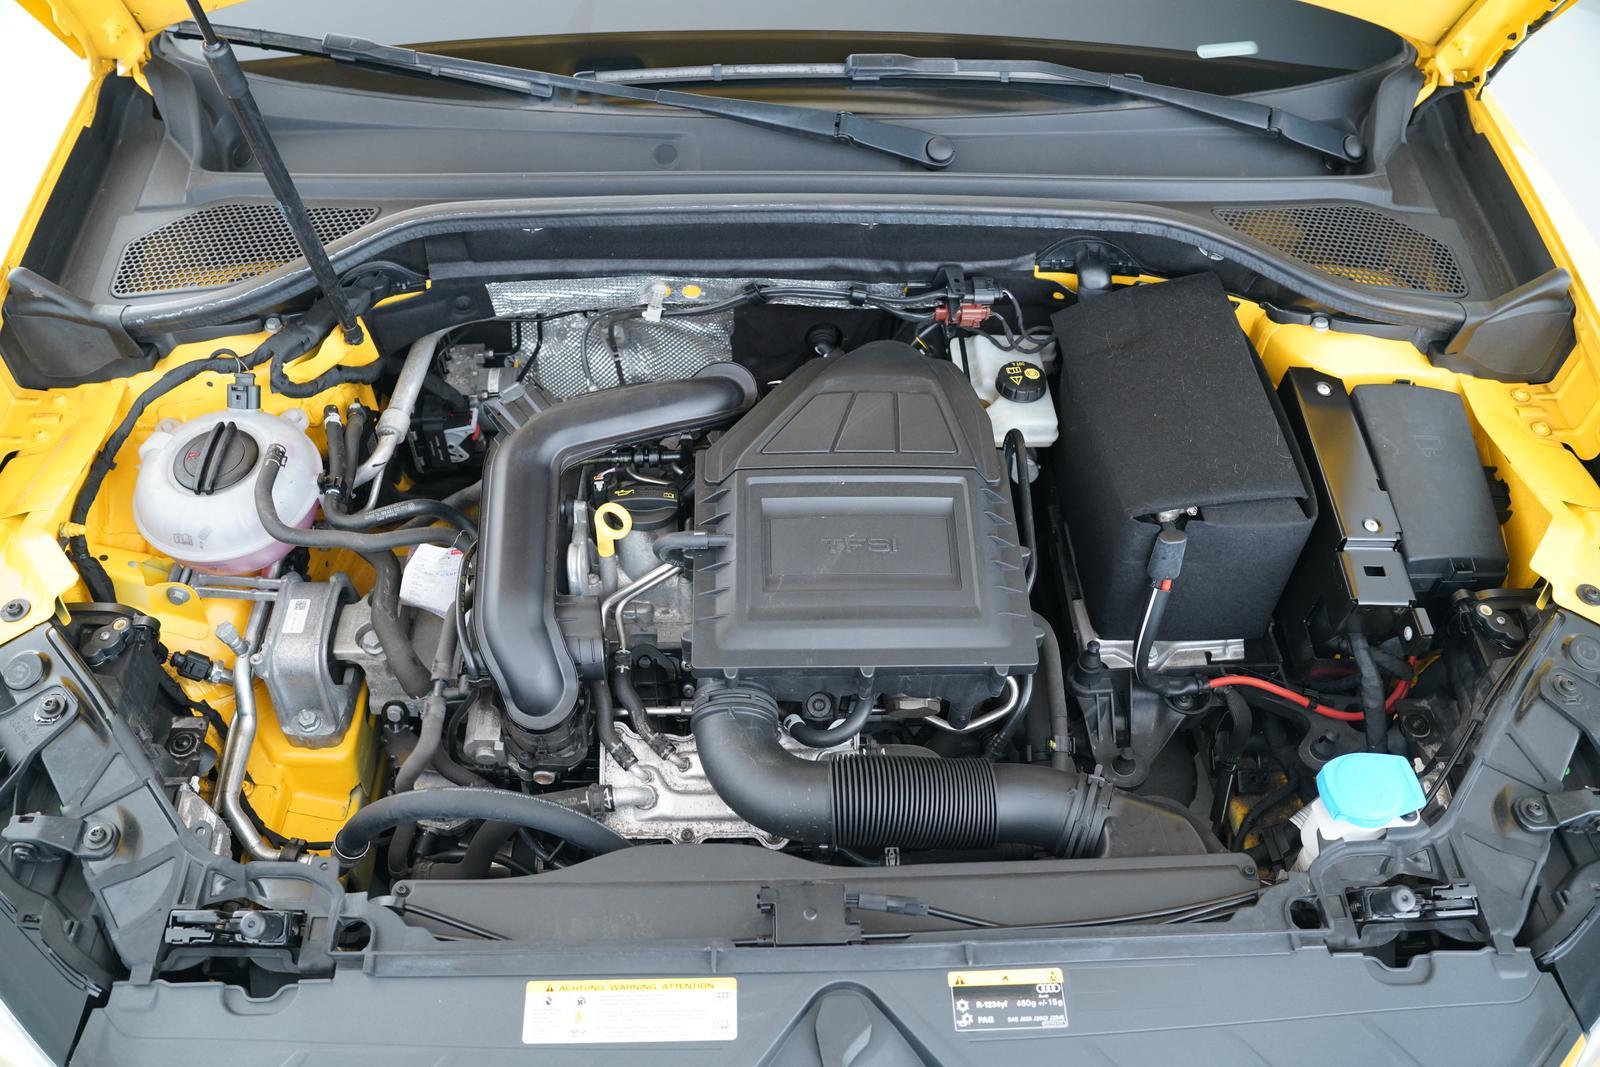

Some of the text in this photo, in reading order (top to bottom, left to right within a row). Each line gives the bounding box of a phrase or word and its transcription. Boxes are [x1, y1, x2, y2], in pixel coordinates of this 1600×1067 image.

[820, 536, 899, 554] TFSI
[609, 983, 656, 991] WARNING
[661, 982, 715, 990] ATTENTION
[977, 1015, 995, 1024] PAG
